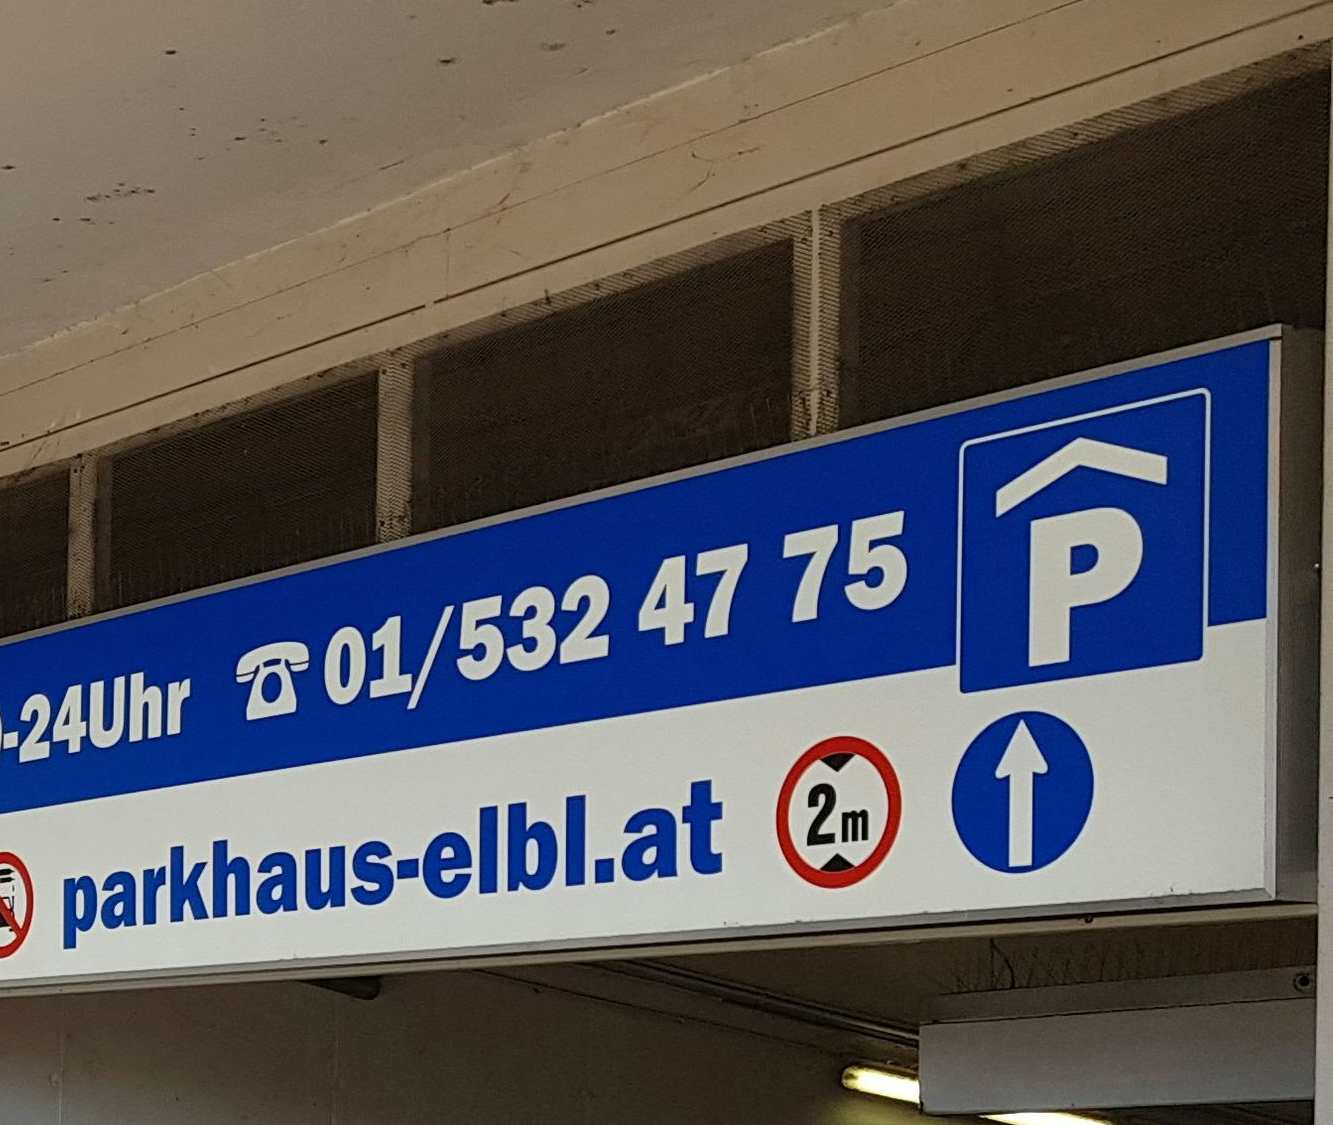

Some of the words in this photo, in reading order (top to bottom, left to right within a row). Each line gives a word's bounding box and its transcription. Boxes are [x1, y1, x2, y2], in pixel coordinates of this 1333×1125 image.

[323, 576, 610, 710] 01/532
[637, 543, 749, 646] 47
[782, 509, 908, 624] 75
[1028, 506, 1144, 670] P
[62, 778, 724, 950] parkhaus-elbl.at
